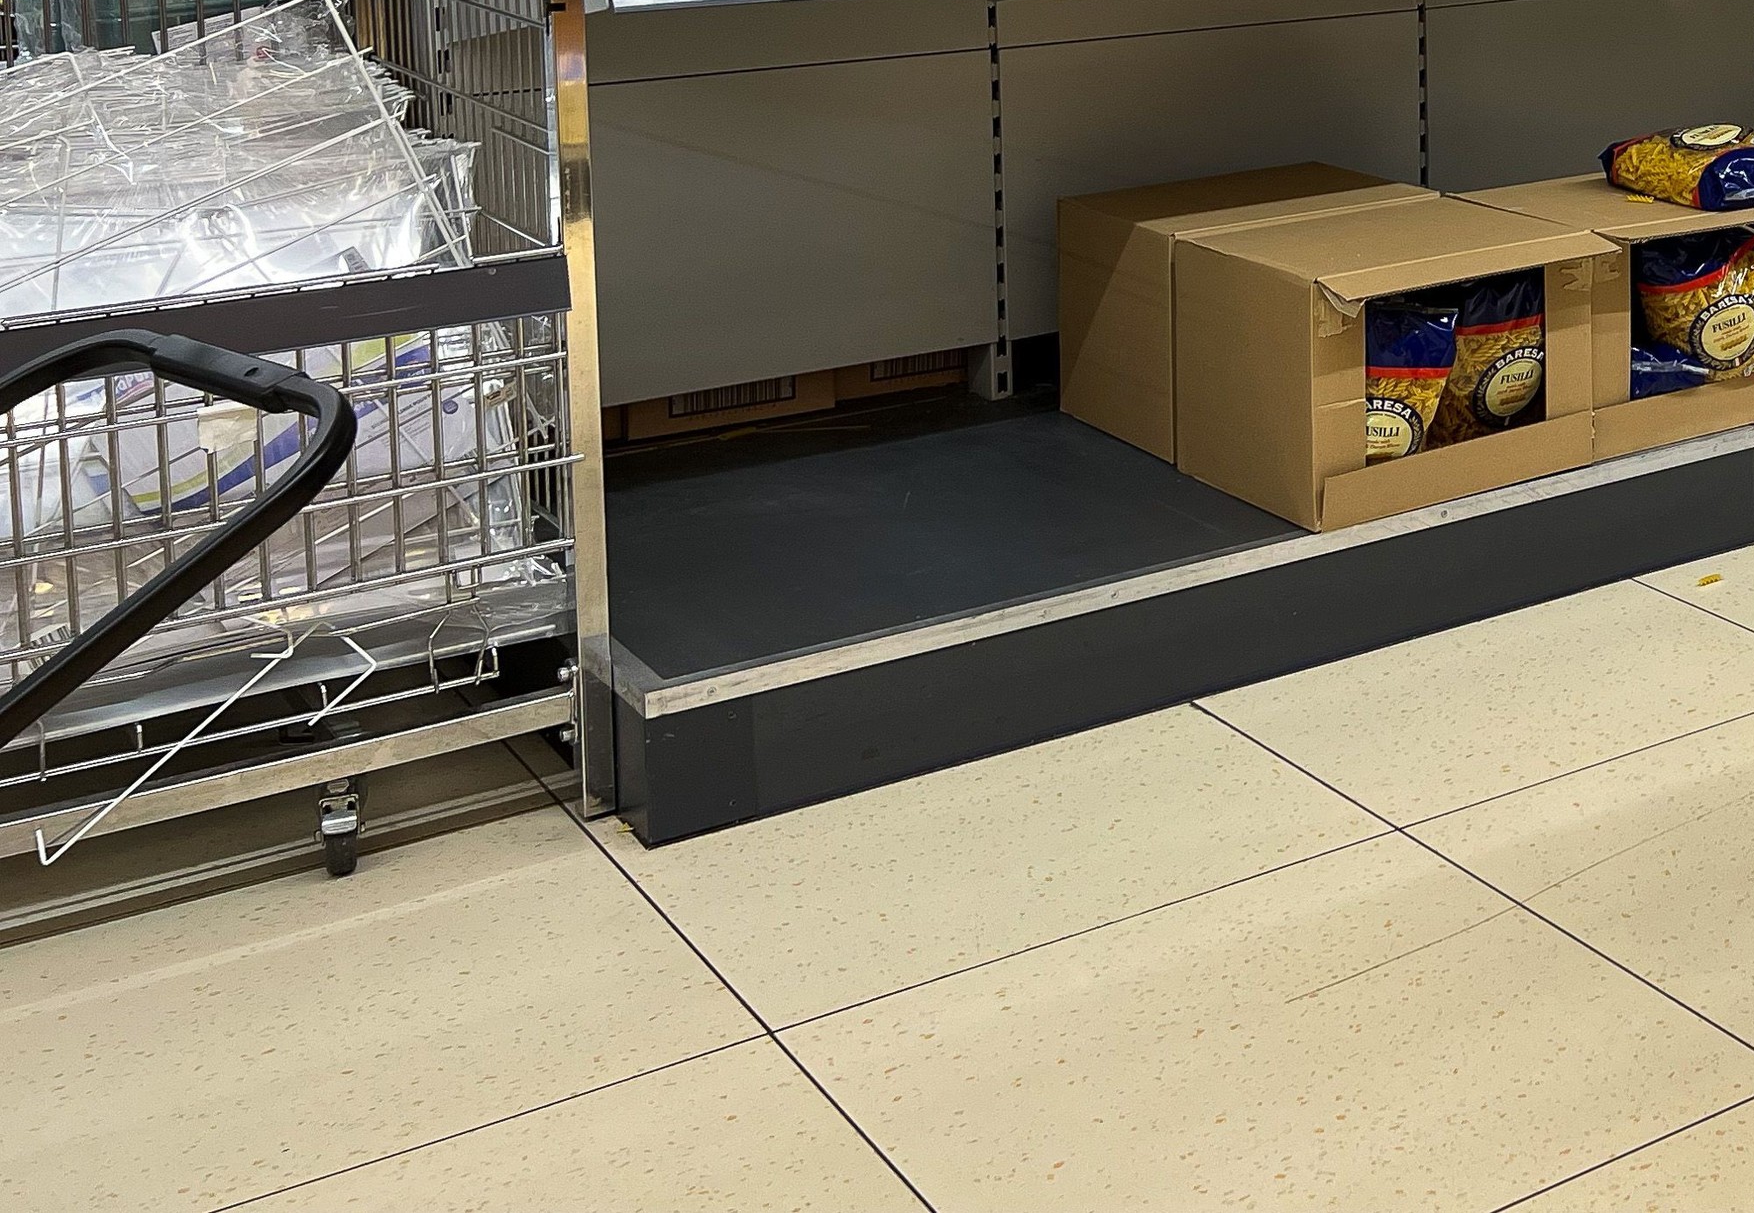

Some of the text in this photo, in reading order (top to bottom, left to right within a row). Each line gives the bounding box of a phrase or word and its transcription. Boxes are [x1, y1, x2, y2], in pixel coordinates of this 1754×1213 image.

[1700, 295, 1747, 321] BARESA
[1711, 312, 1747, 333] FUSILLI
[1495, 347, 1545, 369] BARESA
[1500, 369, 1535, 385] FUSILLI
[1366, 399, 1412, 419] ARESA
[1366, 426, 1400, 438] USILLI
